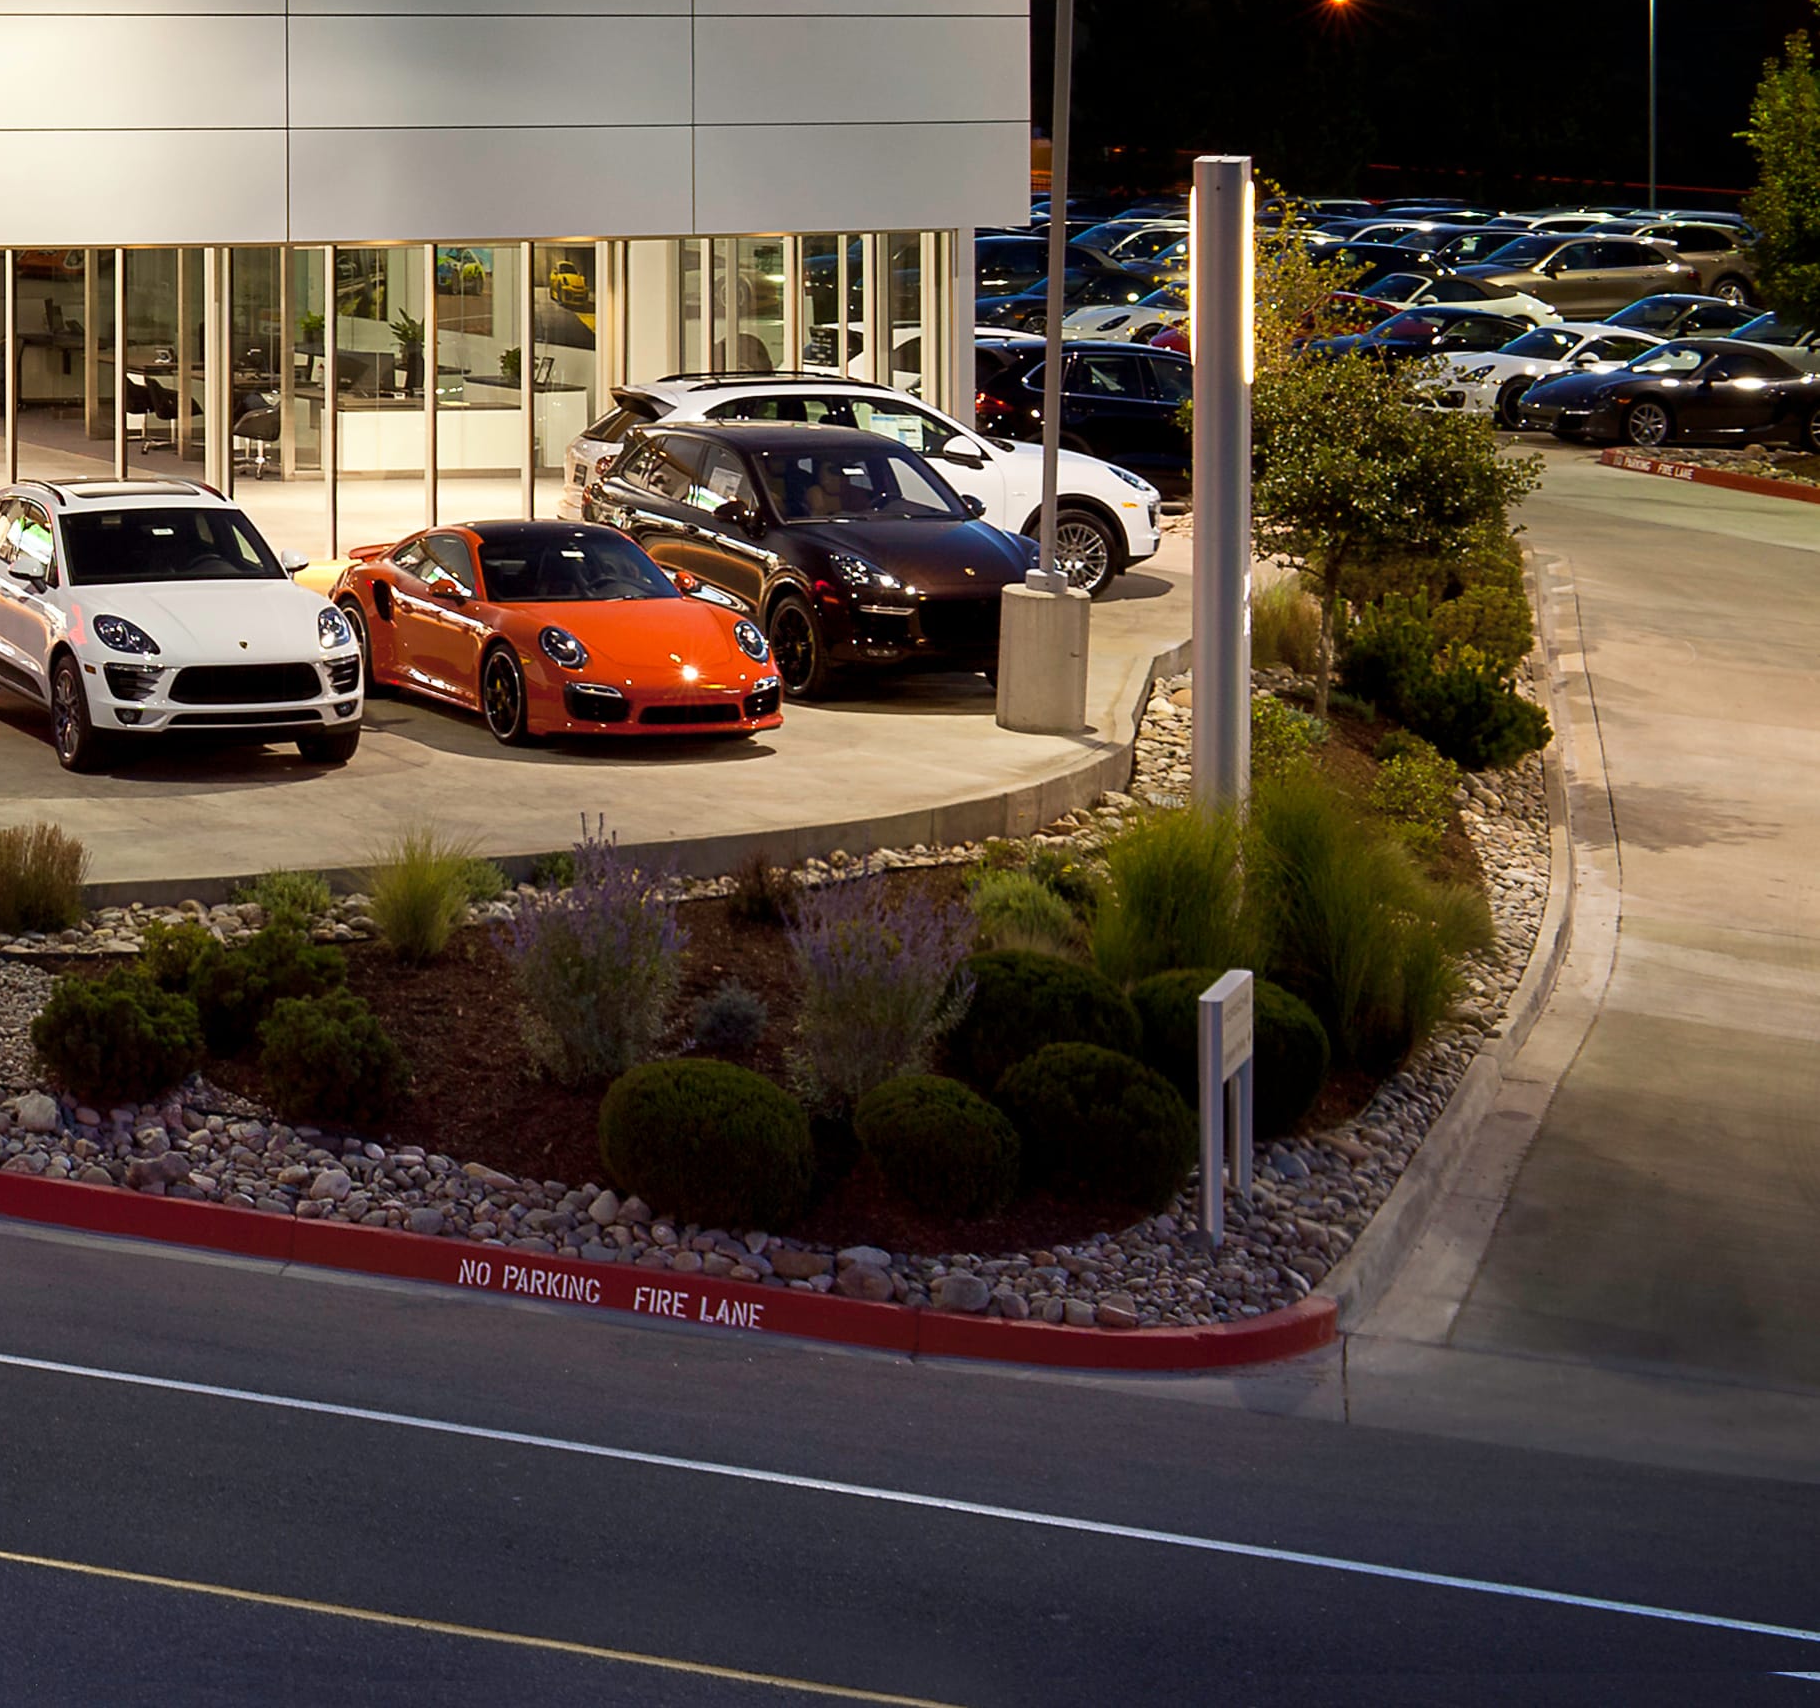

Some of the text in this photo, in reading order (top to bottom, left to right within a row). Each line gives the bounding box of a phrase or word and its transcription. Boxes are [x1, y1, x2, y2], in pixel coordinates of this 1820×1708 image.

[1674, 466, 1694, 480] LANE
[458, 1258, 765, 1330] NO PARKING FIRE LANE
